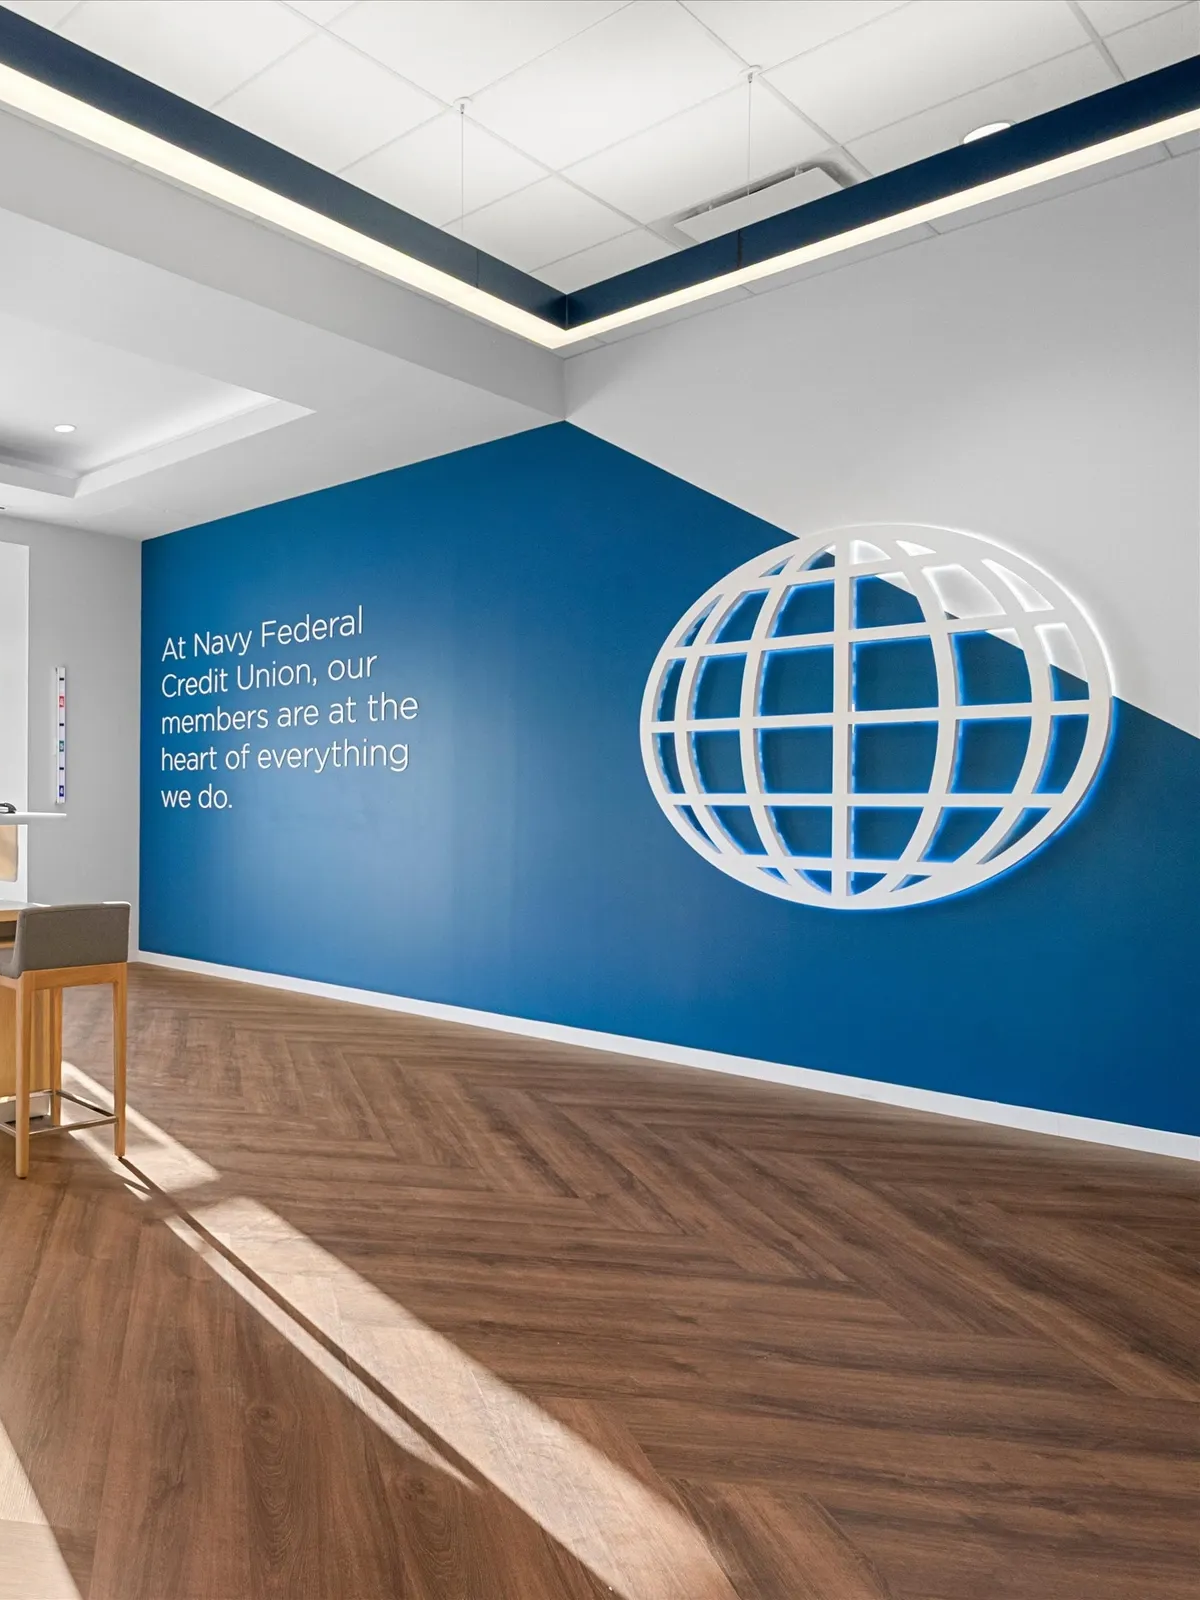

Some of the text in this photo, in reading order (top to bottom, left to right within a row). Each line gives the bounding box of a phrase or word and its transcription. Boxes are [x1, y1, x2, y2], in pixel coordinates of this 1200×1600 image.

[161, 604, 363, 662] At Navy Federal
[161, 655, 378, 698] Credit Union, our
[161, 691, 419, 735] members are at the
[161, 738, 410, 774] heart of everything
[160, 782, 233, 809] we do.
